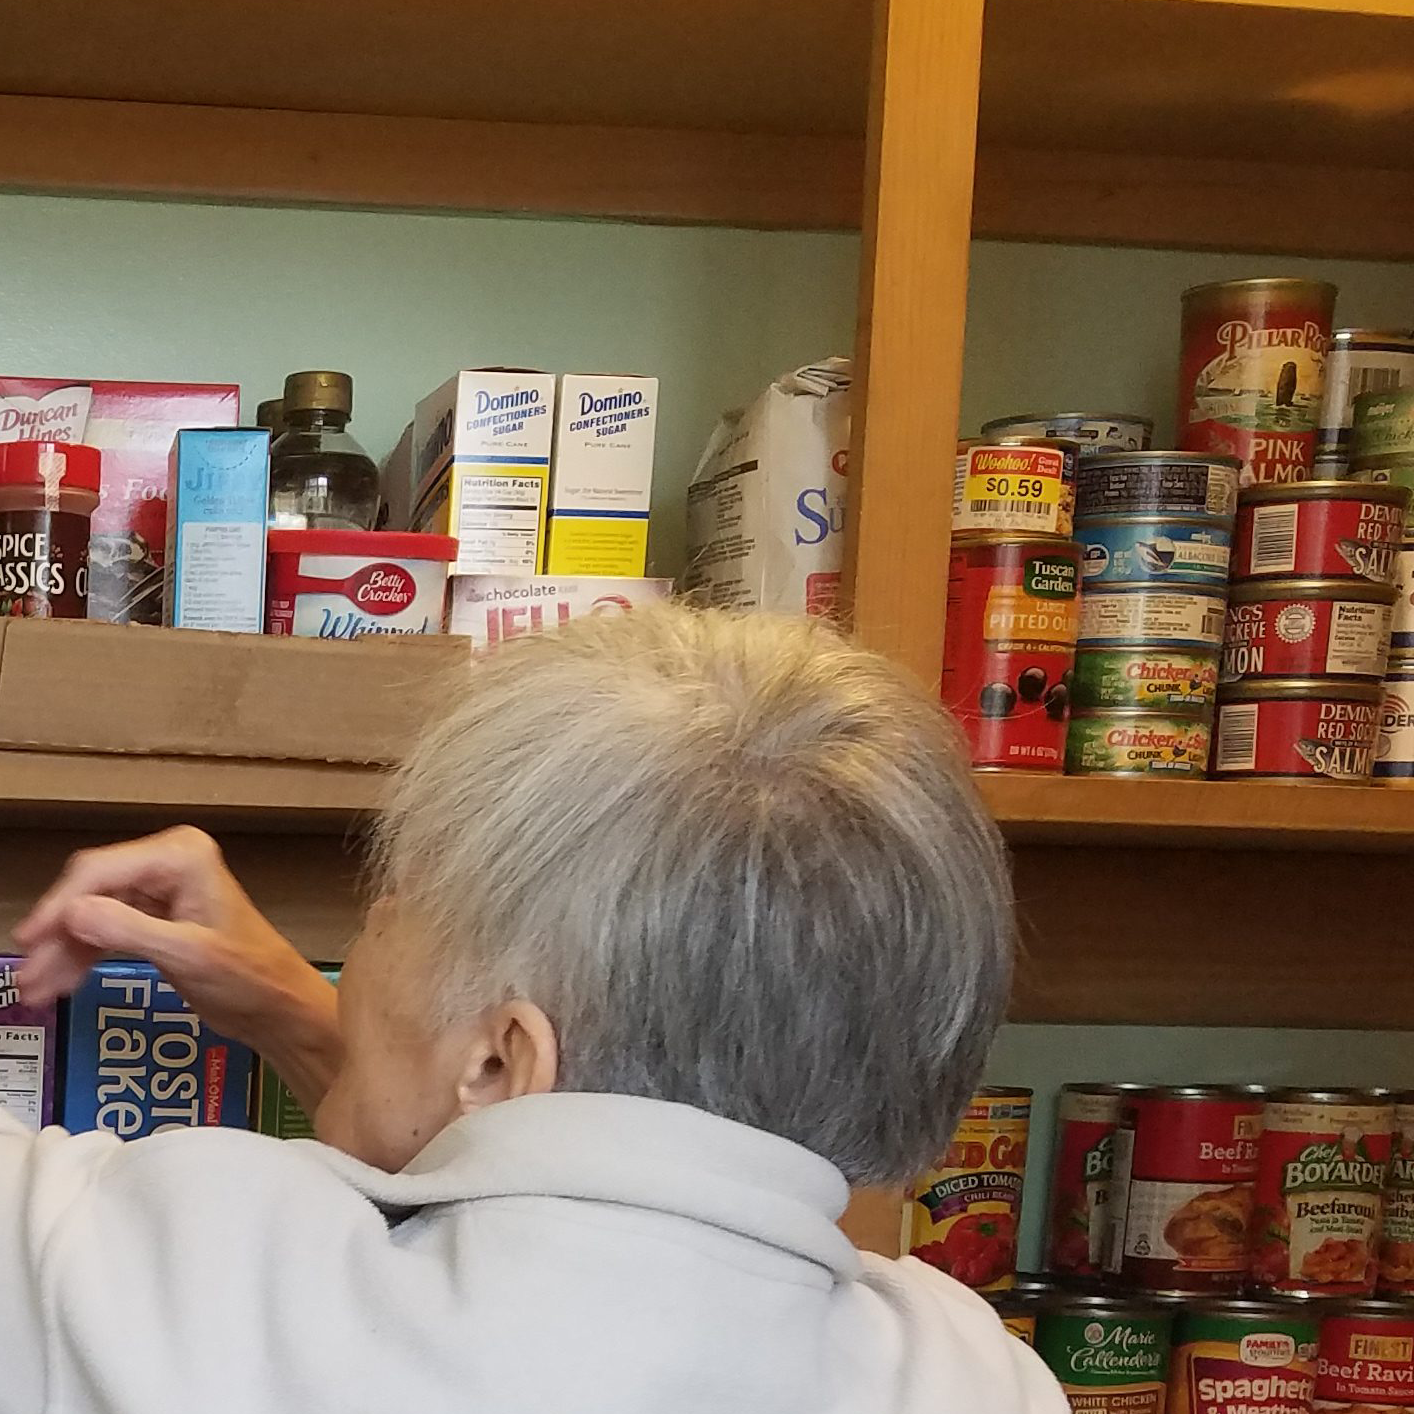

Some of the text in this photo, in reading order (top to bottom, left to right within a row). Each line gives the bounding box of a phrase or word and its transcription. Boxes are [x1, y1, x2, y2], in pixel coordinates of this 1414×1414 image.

[475, 388, 540, 416] Domino
[579, 390, 643, 417] Domino
[466, 404, 547, 431] CONFECTIONERS
[569, 406, 650, 432] CONFECTIONERS
[18, 425, 72, 442] Hines
[492, 421, 524, 436] SUGAR
[596, 423, 627, 438] SUGAR
[1248, 438, 1306, 462] PINK
[975, 453, 1036, 472] Woohoo!
[1239, 462, 1310, 485] ALMO
[124, 478, 168, 501] Foo
[463, 478, 541, 490] Nutrition Facts
[985, 476, 1044, 499] $0.59
[1357, 521, 1383, 541] RED
[1032, 560, 1075, 578] Tuscan
[1353, 546, 1396, 576] SAL
[369, 570, 405, 591] Betty
[1031, 576, 1075, 593] Garden
[357, 583, 411, 604] Crocker
[485, 584, 557, 601] chocolate
[1337, 613, 1363, 622] Facts
[1338, 605, 1376, 615] Nutrition
[989, 614, 1049, 630] PITTED
[1229, 621, 1266, 642] CKEYE
[1126, 661, 1192, 682] Chicken
[1146, 683, 1182, 694] CHUNK
[1320, 703, 1376, 722] DEMIN
[1106, 729, 1175, 749] Chicken
[1317, 721, 1345, 739] RED
[1127, 750, 1165, 760] CHUNK
[1313, 746, 1370, 774] SALM
[5, 1031, 40, 1042] Facts
[95, 977, 152, 1136] FLake
[1199, 1141, 1244, 1161] Beef
[1300, 1143, 1338, 1163] Chef
[935, 1173, 1023, 1199] DICED TOMA
[1296, 1197, 1375, 1219] Beefaroni
[1101, 1324, 1157, 1352] Marie
[1065, 1345, 1162, 1372] Callender's
[1317, 1357, 1414, 1383] Beef Ravi
[1071, 1394, 1157, 1407] WHITE CHICKEN
